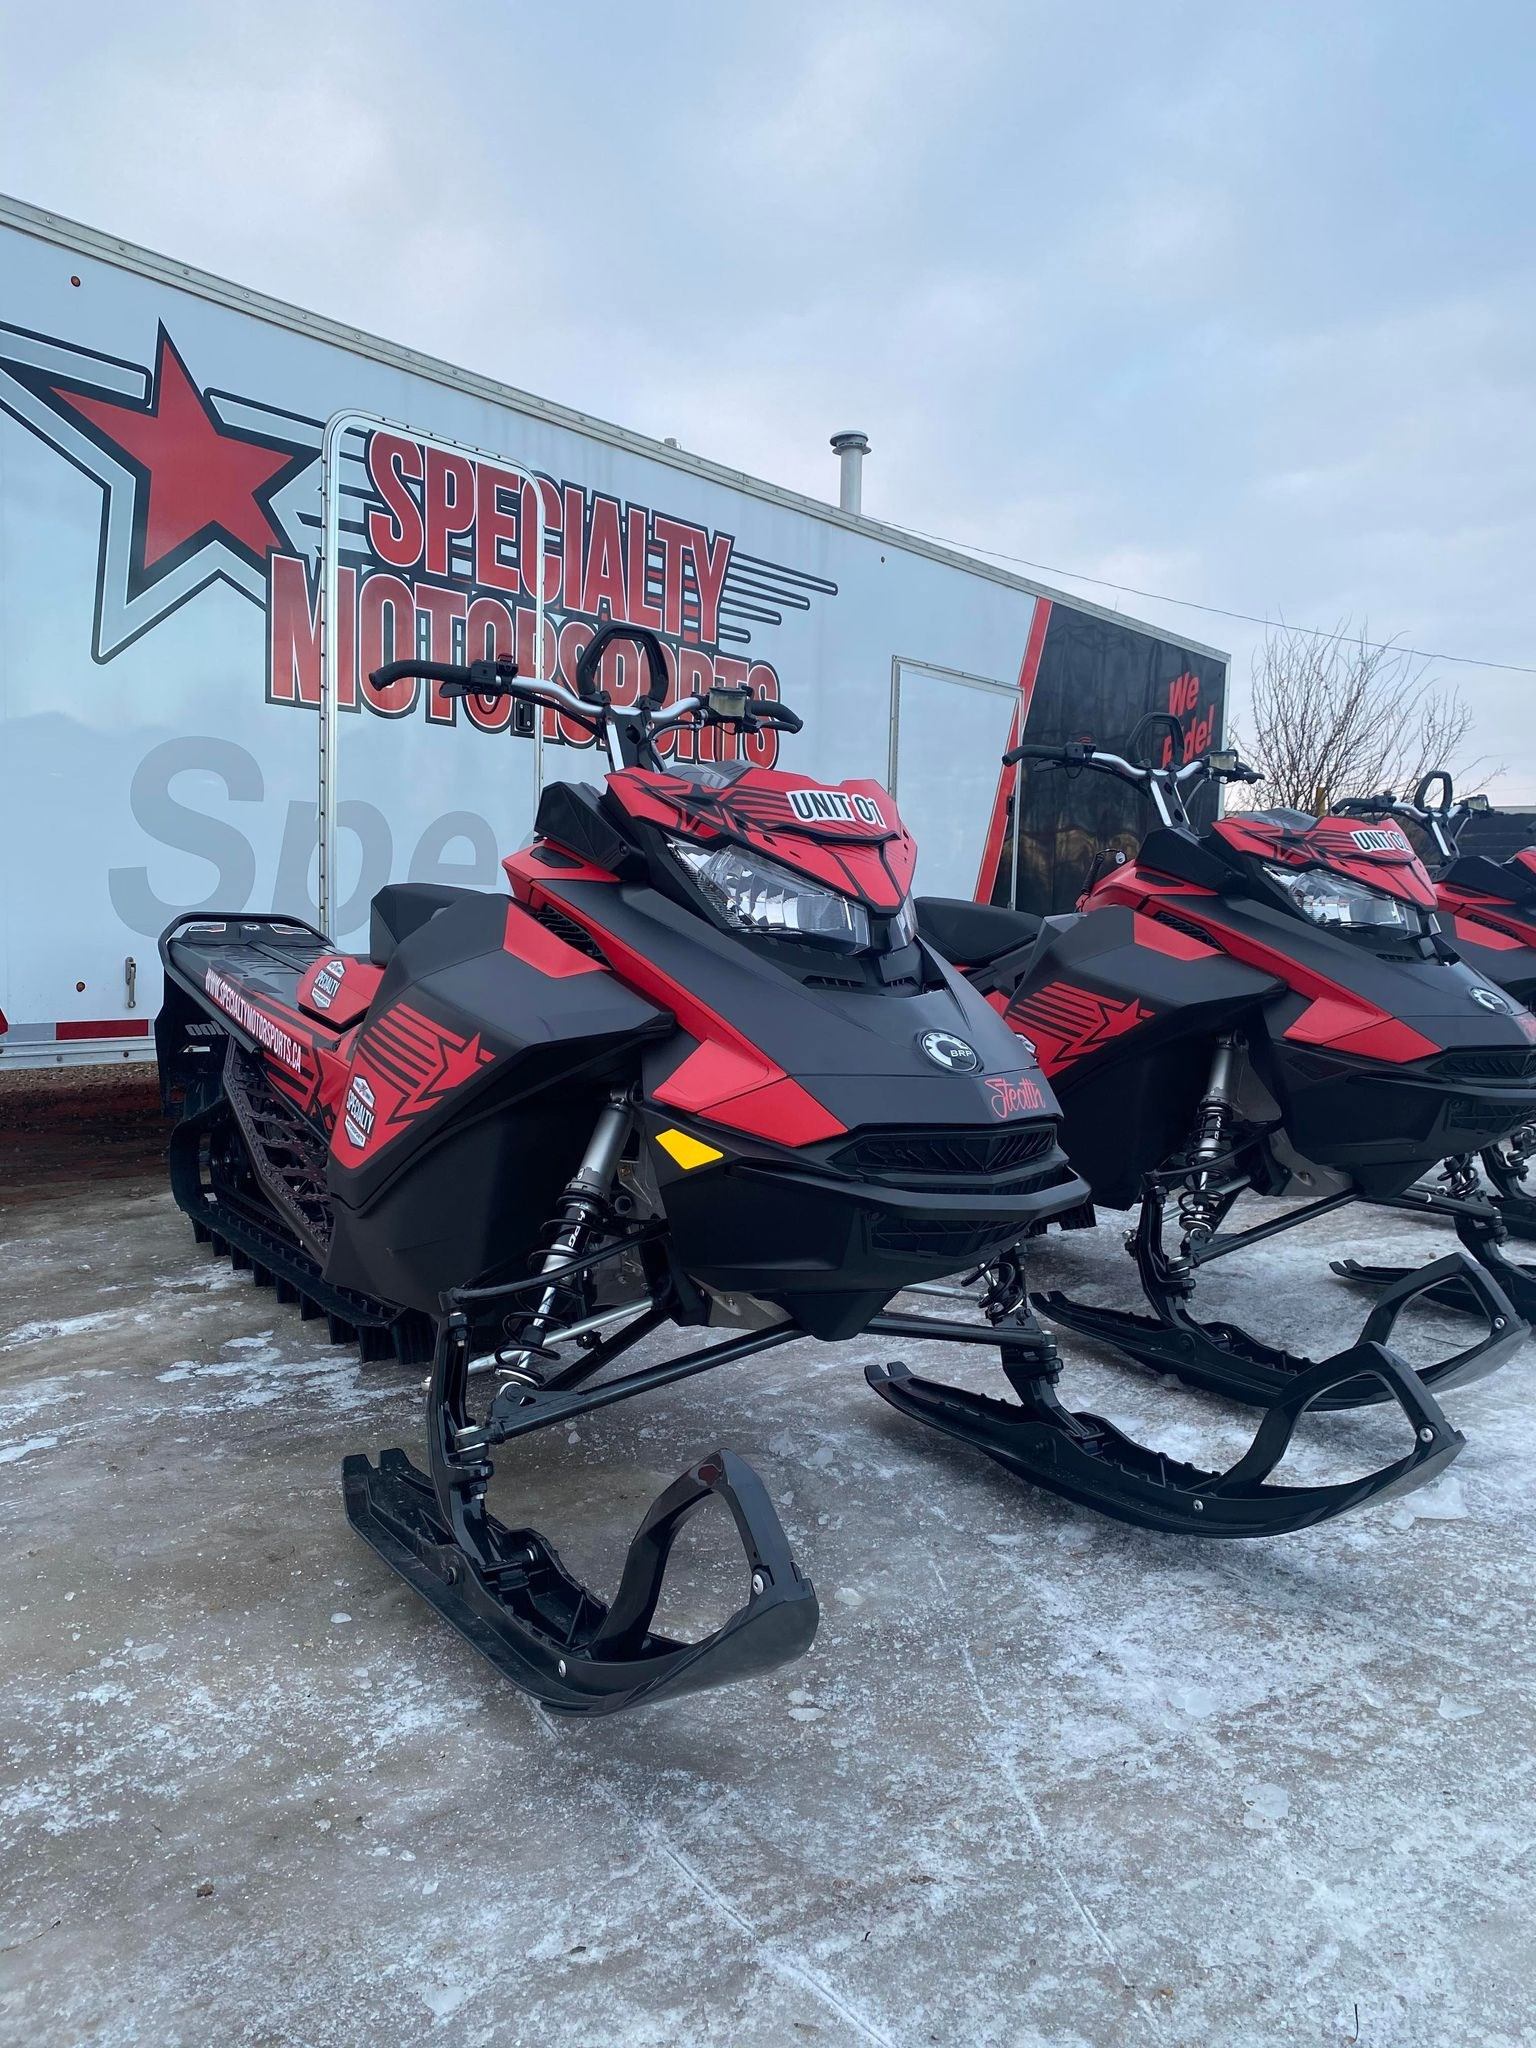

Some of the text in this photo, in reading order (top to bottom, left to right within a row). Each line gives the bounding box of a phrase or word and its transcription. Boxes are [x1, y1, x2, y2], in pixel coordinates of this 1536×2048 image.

[366, 430, 734, 646] SPECIALTY
[1168, 671, 1199, 717] We
[1161, 704, 1214, 769] Rde!
[789, 791, 886, 827] UNIT 01
[108, 735, 535, 942] Spe
[1352, 830, 1394, 851] UNIT
[949, 1049, 973, 1058] BRP
[984, 1076, 1047, 1119] Stealth
